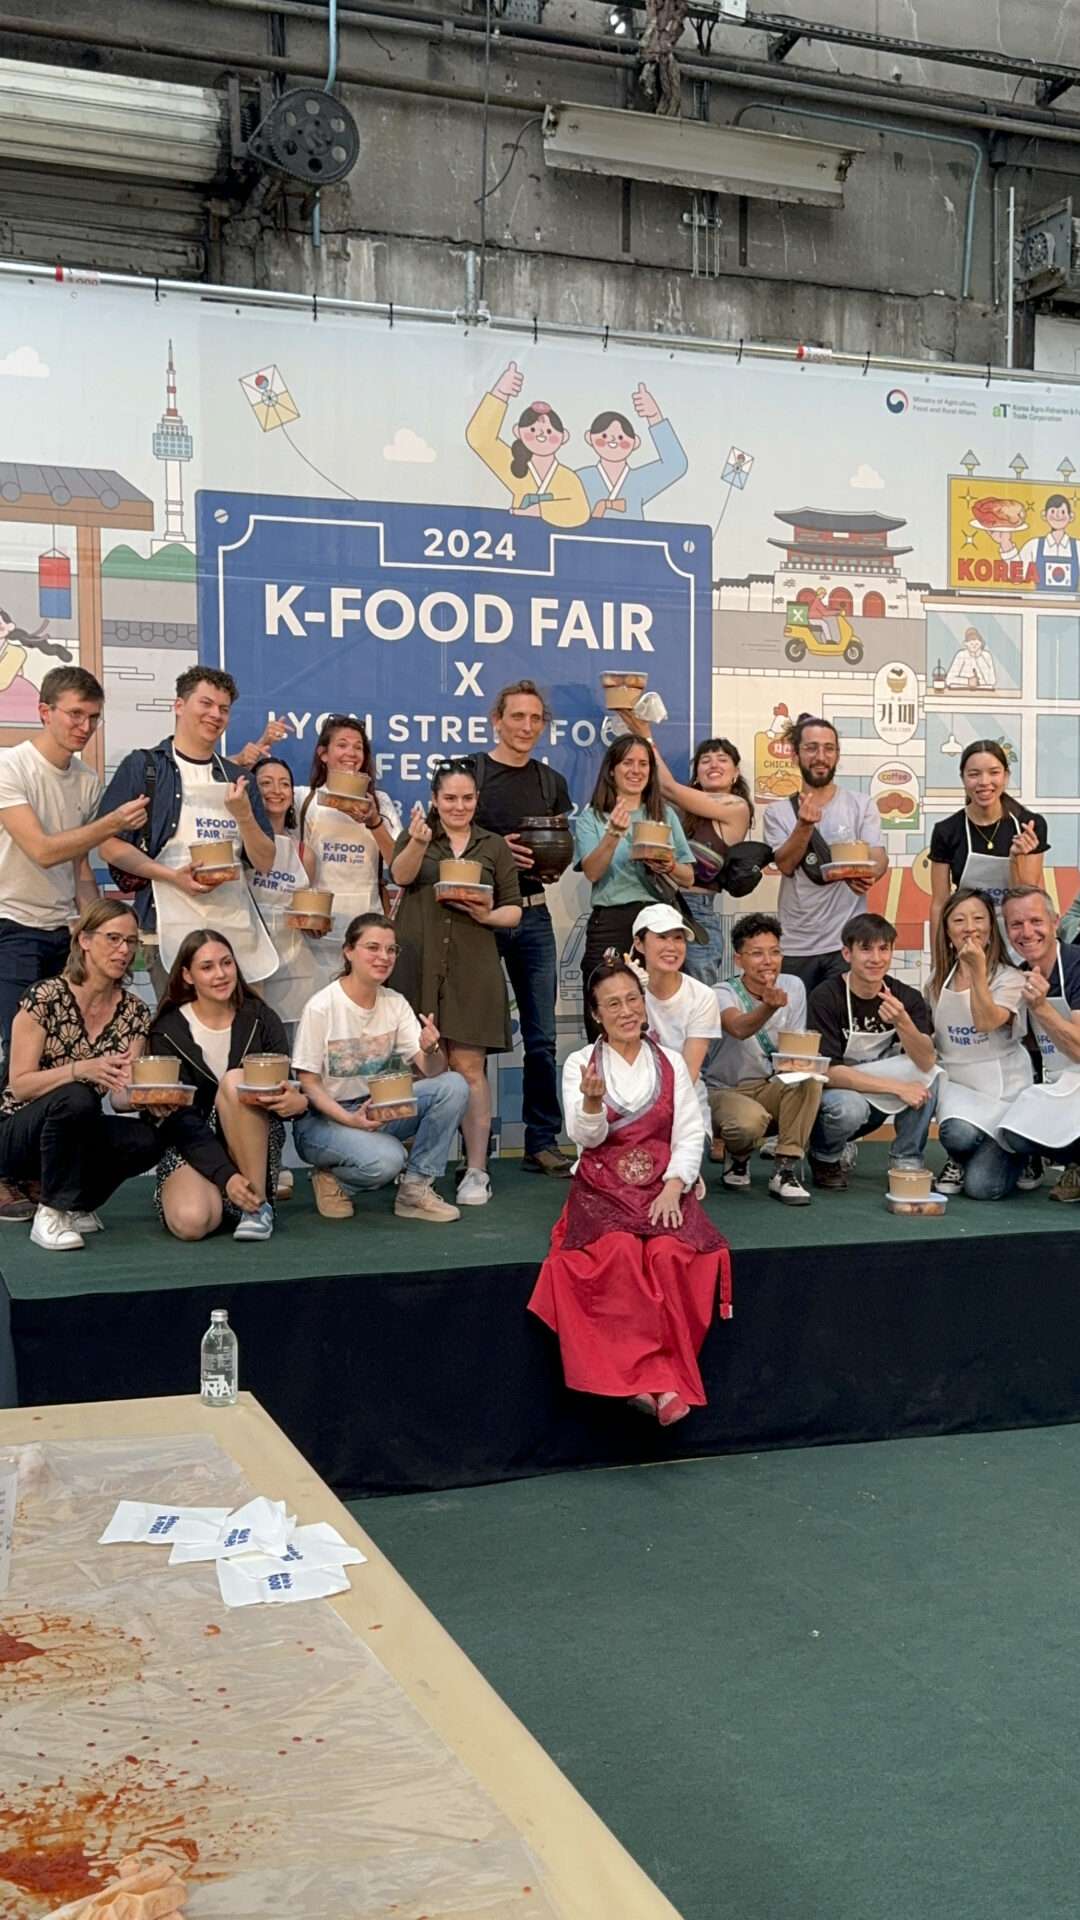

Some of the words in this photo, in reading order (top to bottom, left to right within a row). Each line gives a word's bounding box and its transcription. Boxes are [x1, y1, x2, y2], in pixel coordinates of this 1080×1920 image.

[423, 527, 517, 562] 2024
[957, 557, 1040, 582] KOREA
[264, 583, 514, 644] K-FOOD
[530, 597, 656, 652] FAIR
[453, 660, 485, 697] X
[195, 816, 237, 829] K-FOOD
[197, 829, 220, 839] FAIR
[322, 842, 365, 854] K-FOOD
[322, 852, 347, 863] FAIR
[253, 877, 279, 891] FAIR
